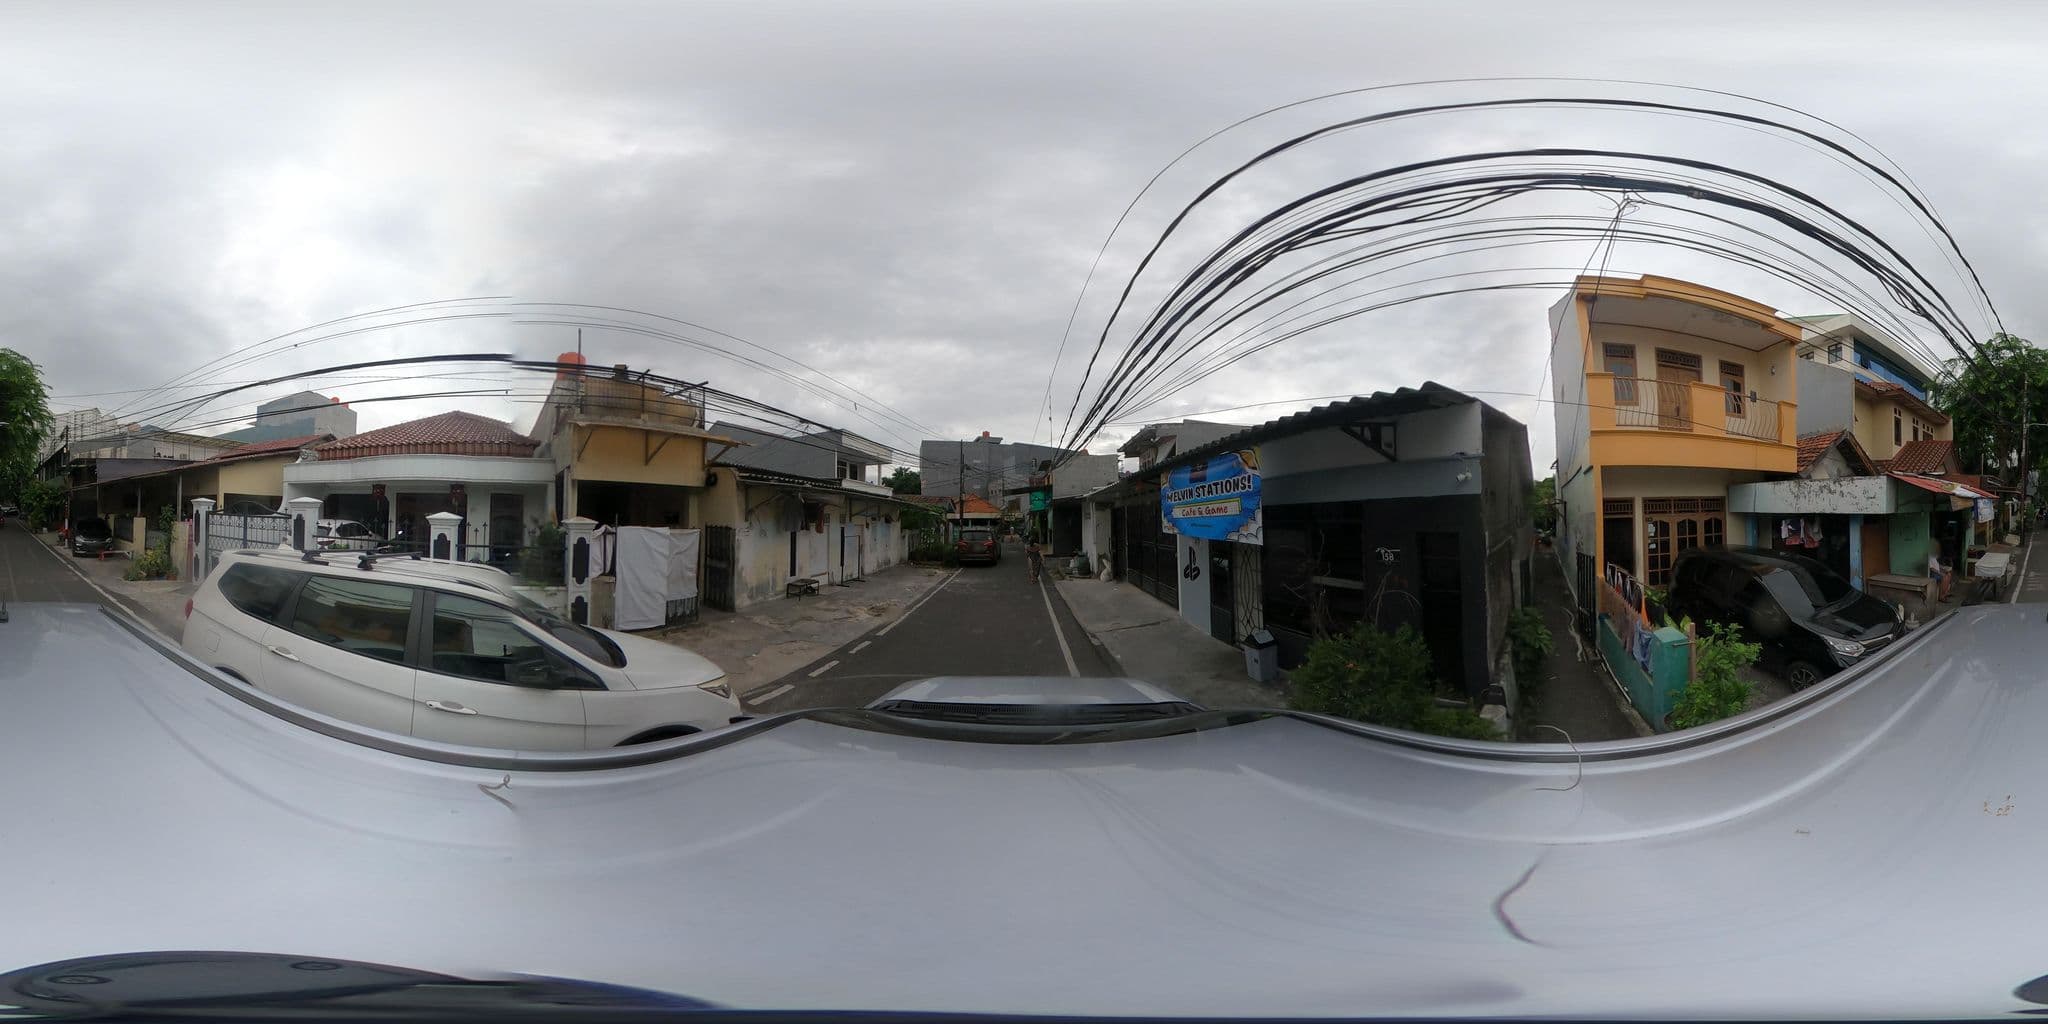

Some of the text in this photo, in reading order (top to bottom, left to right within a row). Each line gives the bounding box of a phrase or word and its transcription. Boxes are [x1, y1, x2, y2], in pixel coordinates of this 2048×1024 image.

[1167, 475, 1252, 503] MELVIN STATIONS!
[1204, 505, 1228, 515] Game
